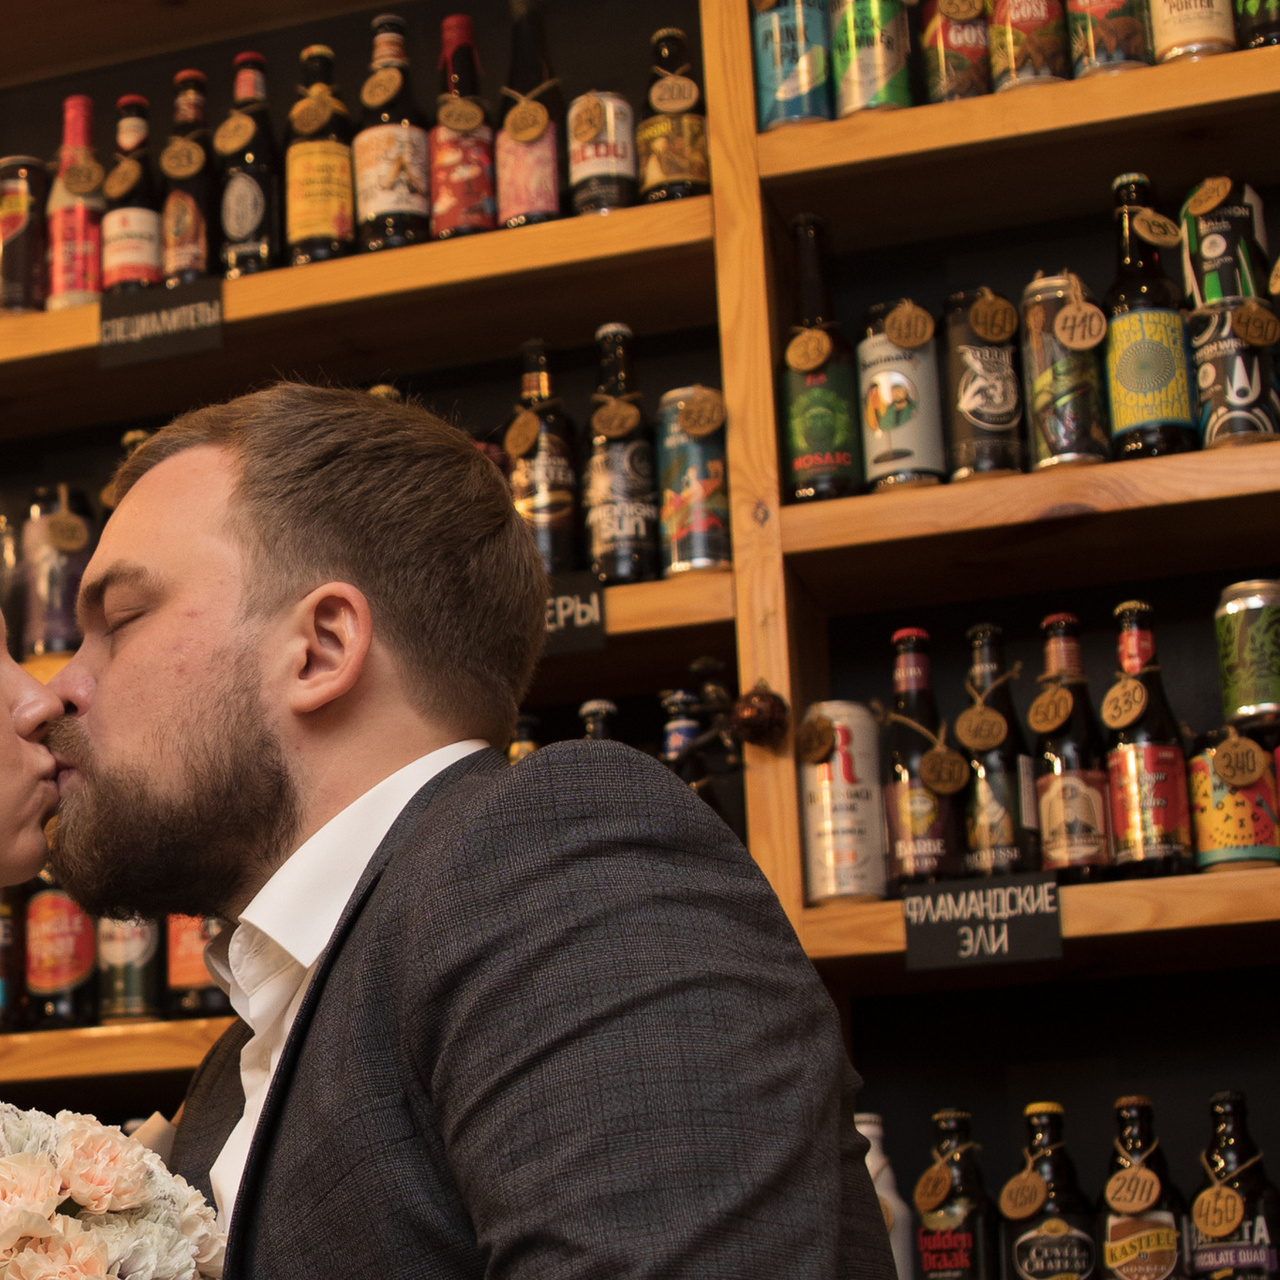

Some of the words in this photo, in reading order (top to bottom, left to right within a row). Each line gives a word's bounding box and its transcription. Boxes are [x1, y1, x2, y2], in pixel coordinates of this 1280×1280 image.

[792, 451, 852, 472] MOSAIC
[1110, 684, 1146, 720] 330
[1222, 748, 1257, 779] 340
[903, 880, 1059, 926] ФЛАМАНДСКИЕ
[956, 922, 1009, 959] ЭЛИ
[1238, 1249, 1267, 1263] QUAD
